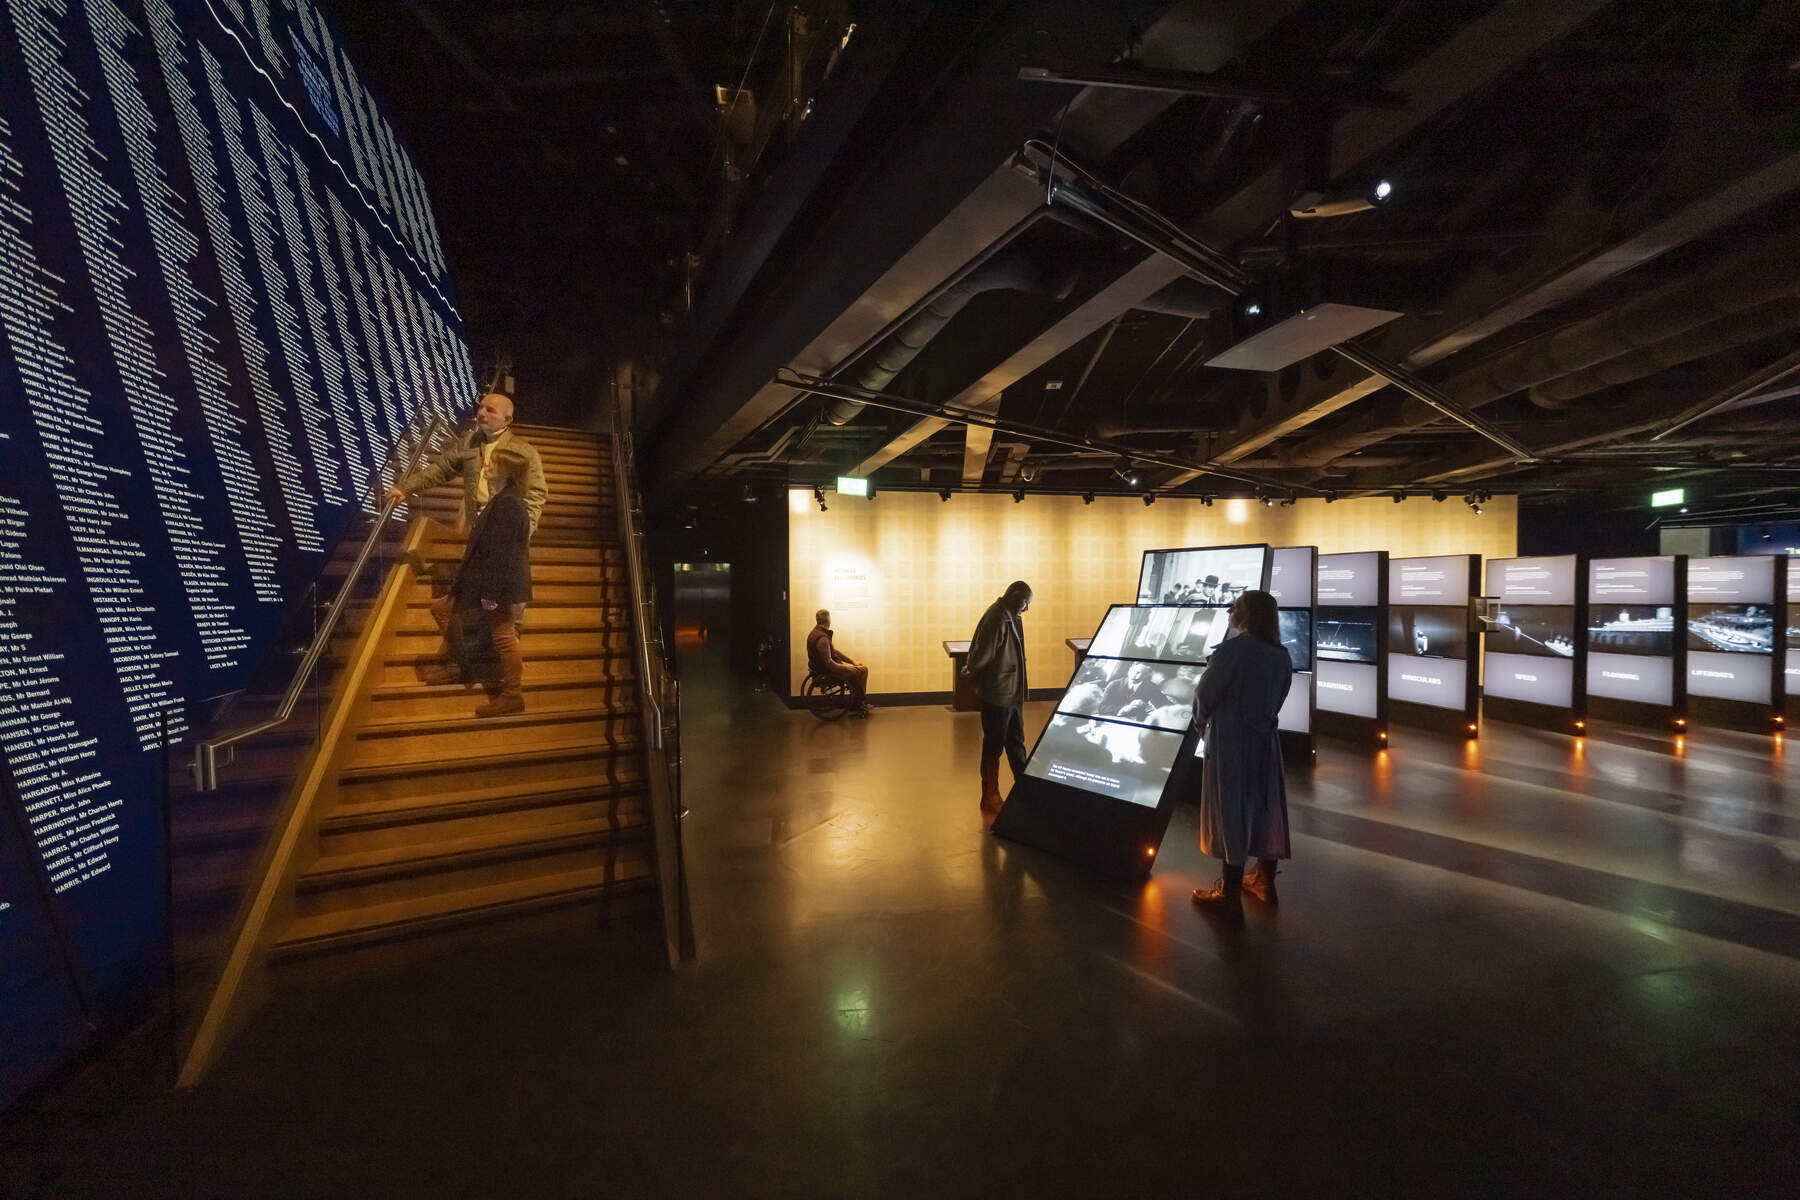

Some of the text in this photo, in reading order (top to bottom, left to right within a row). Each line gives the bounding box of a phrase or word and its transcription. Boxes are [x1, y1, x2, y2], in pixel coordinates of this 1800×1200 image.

[26, 689, 50, 698] Bernard
[40, 712, 61, 720] George
[0, 729, 32, 740] HANSEN,
[4, 740, 36, 752] HANSEN,
[46, 734, 66, 743] Henrik
[8, 752, 40, 764] HANSEN,
[50, 746, 67, 754] Henry
[68, 738, 98, 749] Damsgaard
[13, 762, 48, 776] HARBECK,
[58, 755, 79, 764] William
[79, 750, 95, 758] Henry
[17, 775, 51, 788] HARDING,
[21, 772, 101, 800] HARGADON, Miss Katherine
[26, 780, 111, 812] HARKNETT, Miss Alice Phoebe
[30, 810, 60, 824] HARPER,
[78, 799, 91, 807] John
[34, 815, 78, 836] HARRINGTON,
[88, 805, 108, 815] Charles
[108, 799, 122, 808] Henry
[38, 833, 66, 847] HARRIS,
[76, 823, 91, 833] Amos
[91, 813, 116, 826] Frederick
[42, 824, 119, 859] HARRIS, Mr Charles William
[46, 856, 74, 871] HARRIS,
[83, 842, 103, 854] Clifford
[103, 836, 119, 846] Henry
[51, 852, 107, 882] HARRIS, Mr Edward
[55, 878, 82, 894] HARRIS,
[91, 863, 111, 876] Edward
